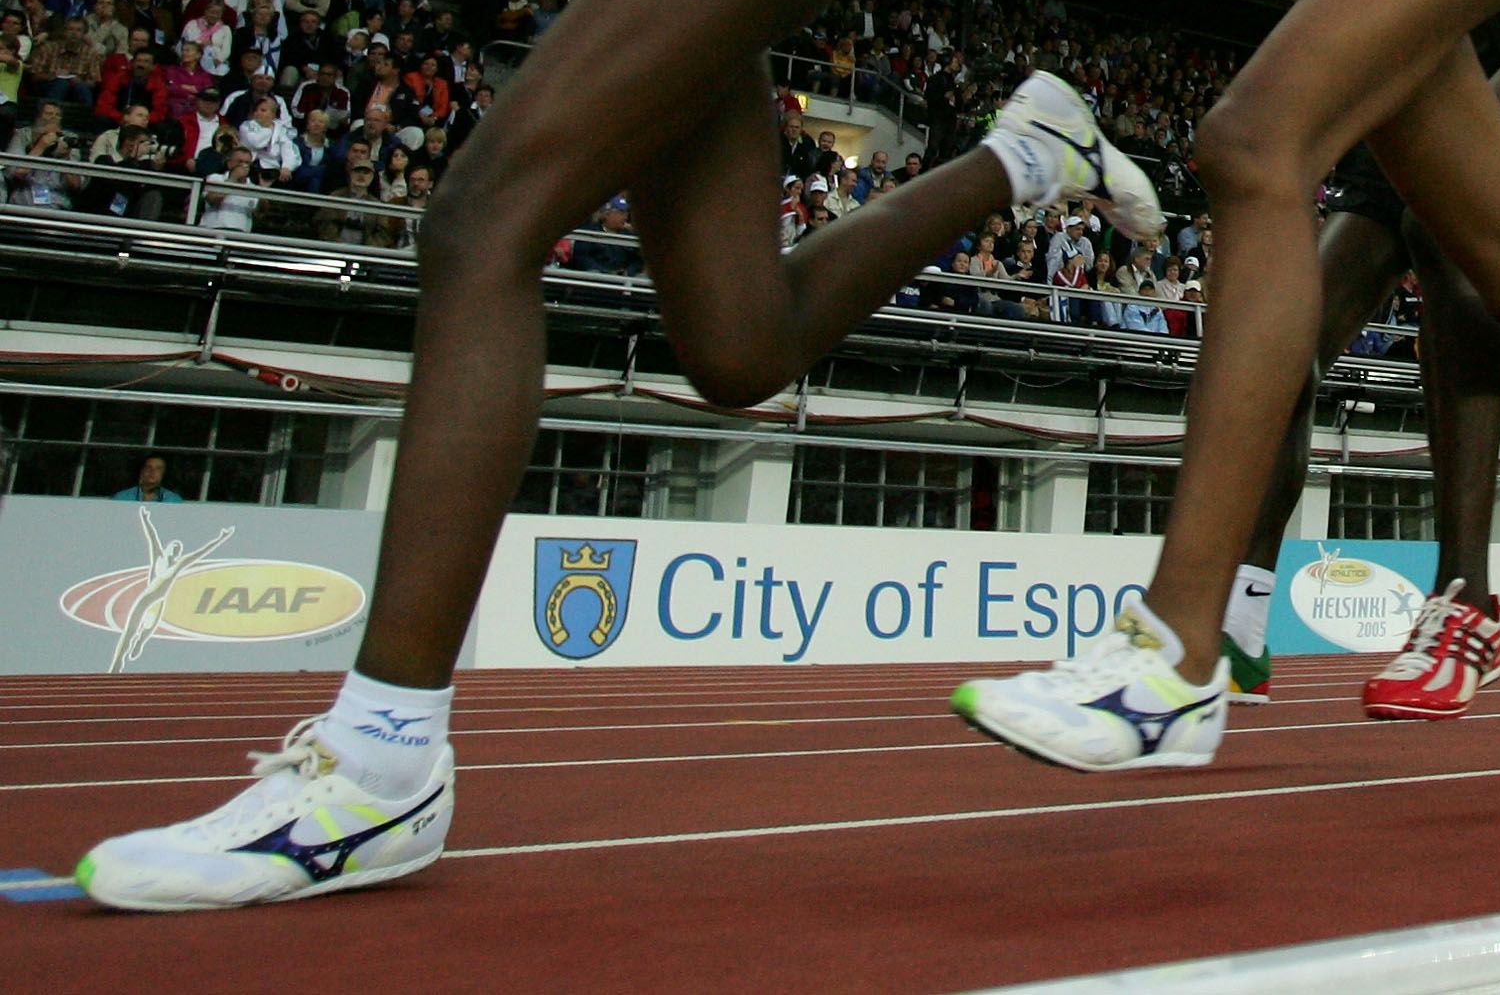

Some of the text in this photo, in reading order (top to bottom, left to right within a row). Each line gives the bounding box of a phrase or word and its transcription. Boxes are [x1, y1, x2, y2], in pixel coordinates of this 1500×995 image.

[193, 585, 326, 615] IAAF
[657, 553, 1153, 663] City of Espo
[1312, 596, 1387, 620] HELSINKI
[1356, 621, 1387, 638] 2005
